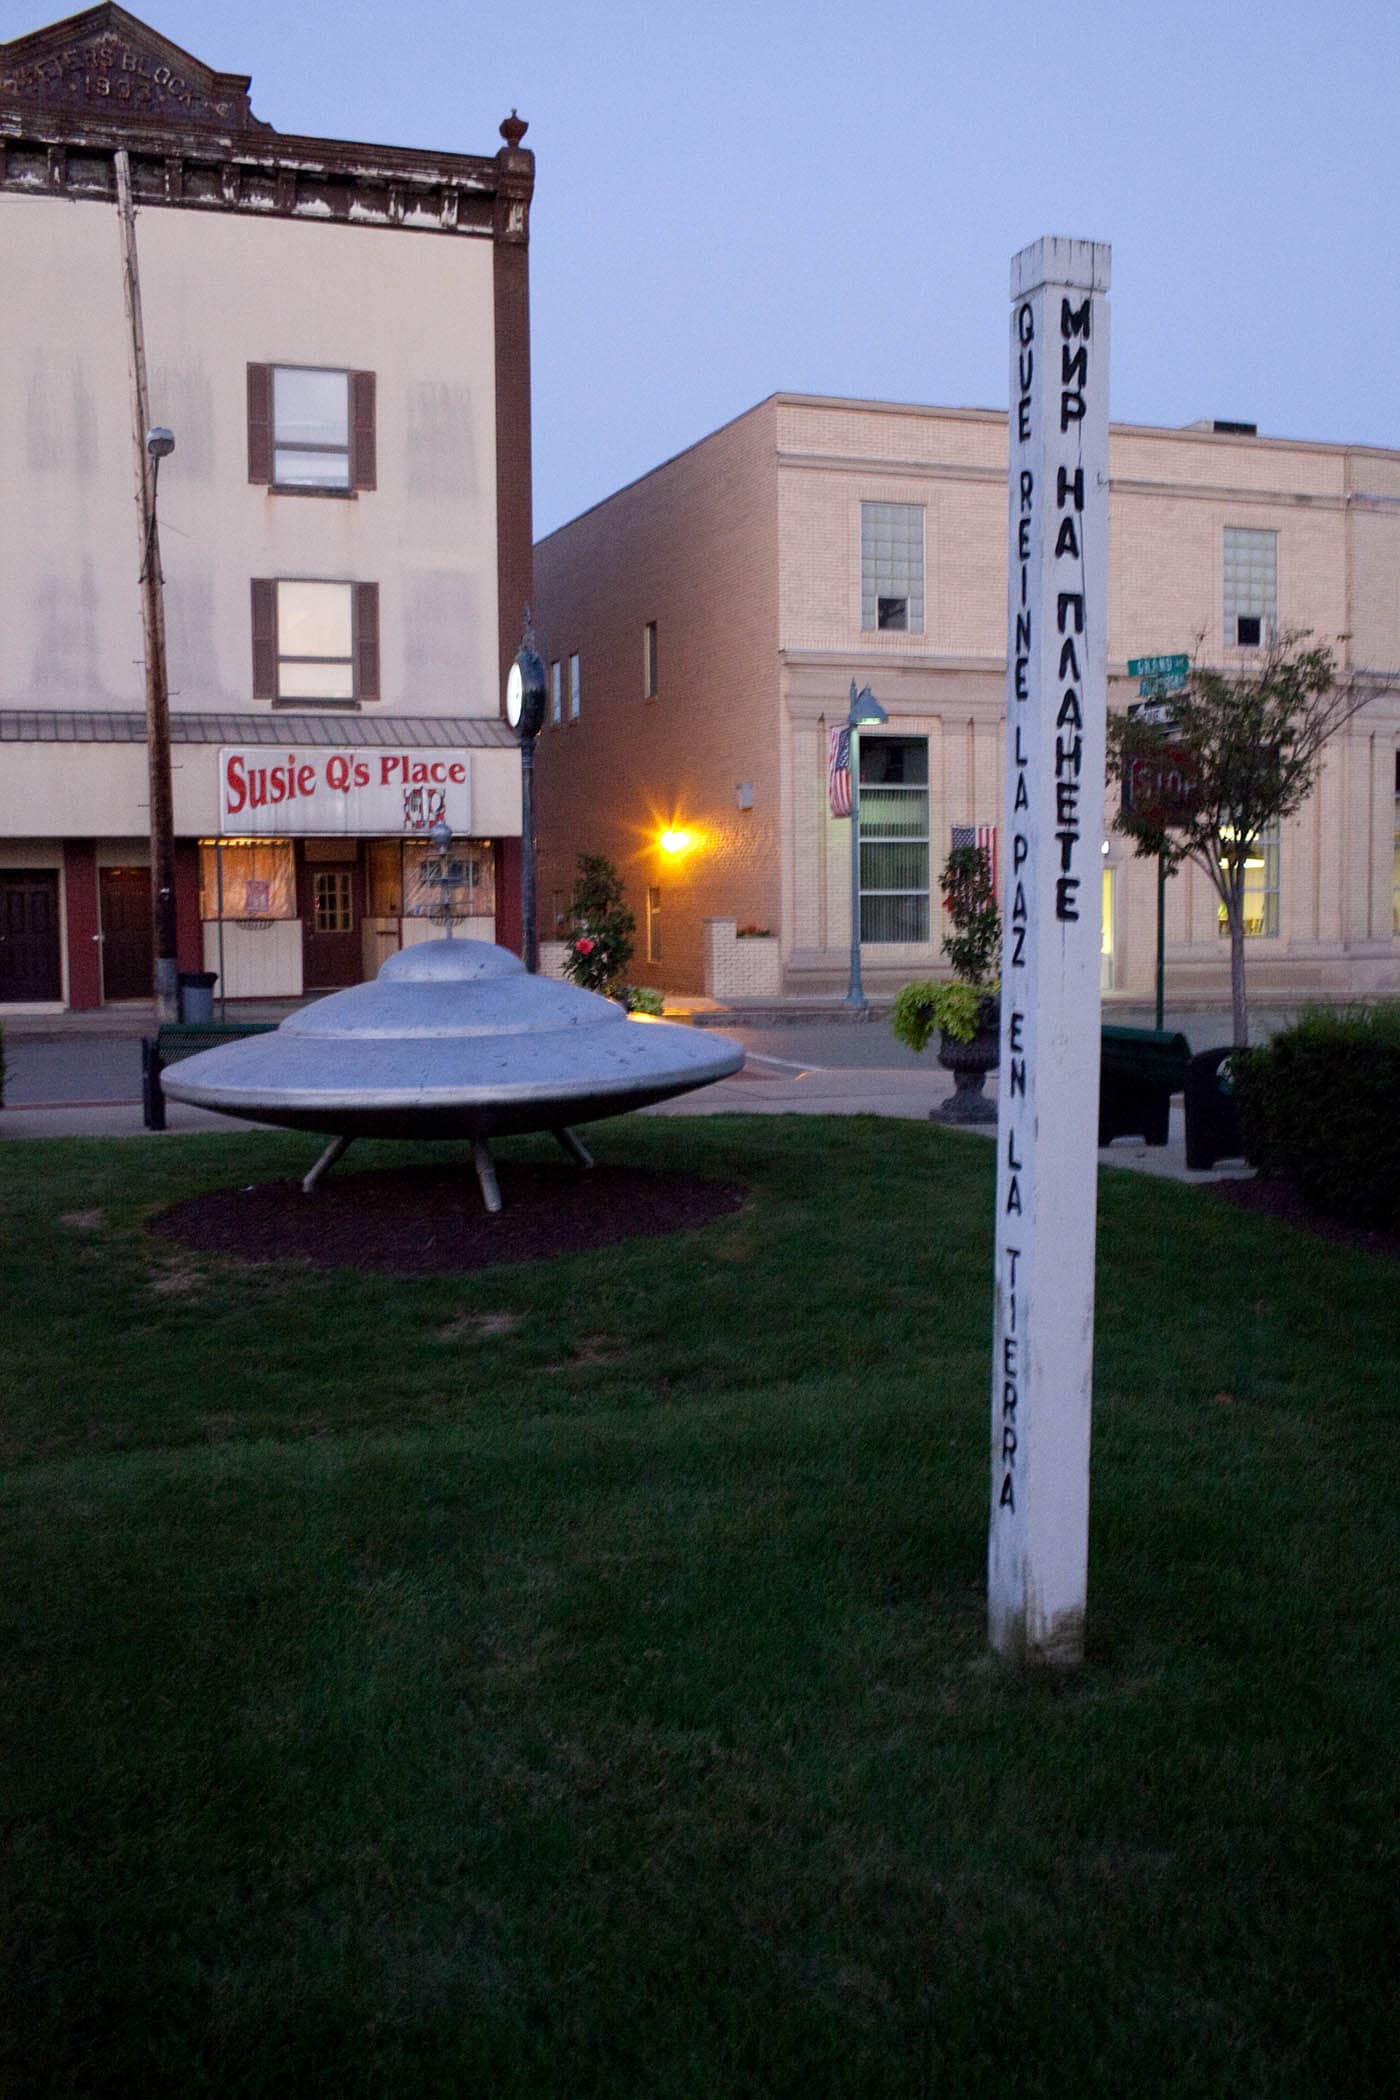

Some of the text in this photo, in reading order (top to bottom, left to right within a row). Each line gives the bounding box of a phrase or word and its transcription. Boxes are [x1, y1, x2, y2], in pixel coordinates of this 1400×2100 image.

[1055, 297, 1091, 922] МИР НА ПЛАНЕТЕ
[1137, 657, 1173, 675] GRAND
[226, 753, 467, 815] Susie Q's Place
[1000, 302, 1034, 1515] QUE REINE LA PAZ EN LA TIERRA
